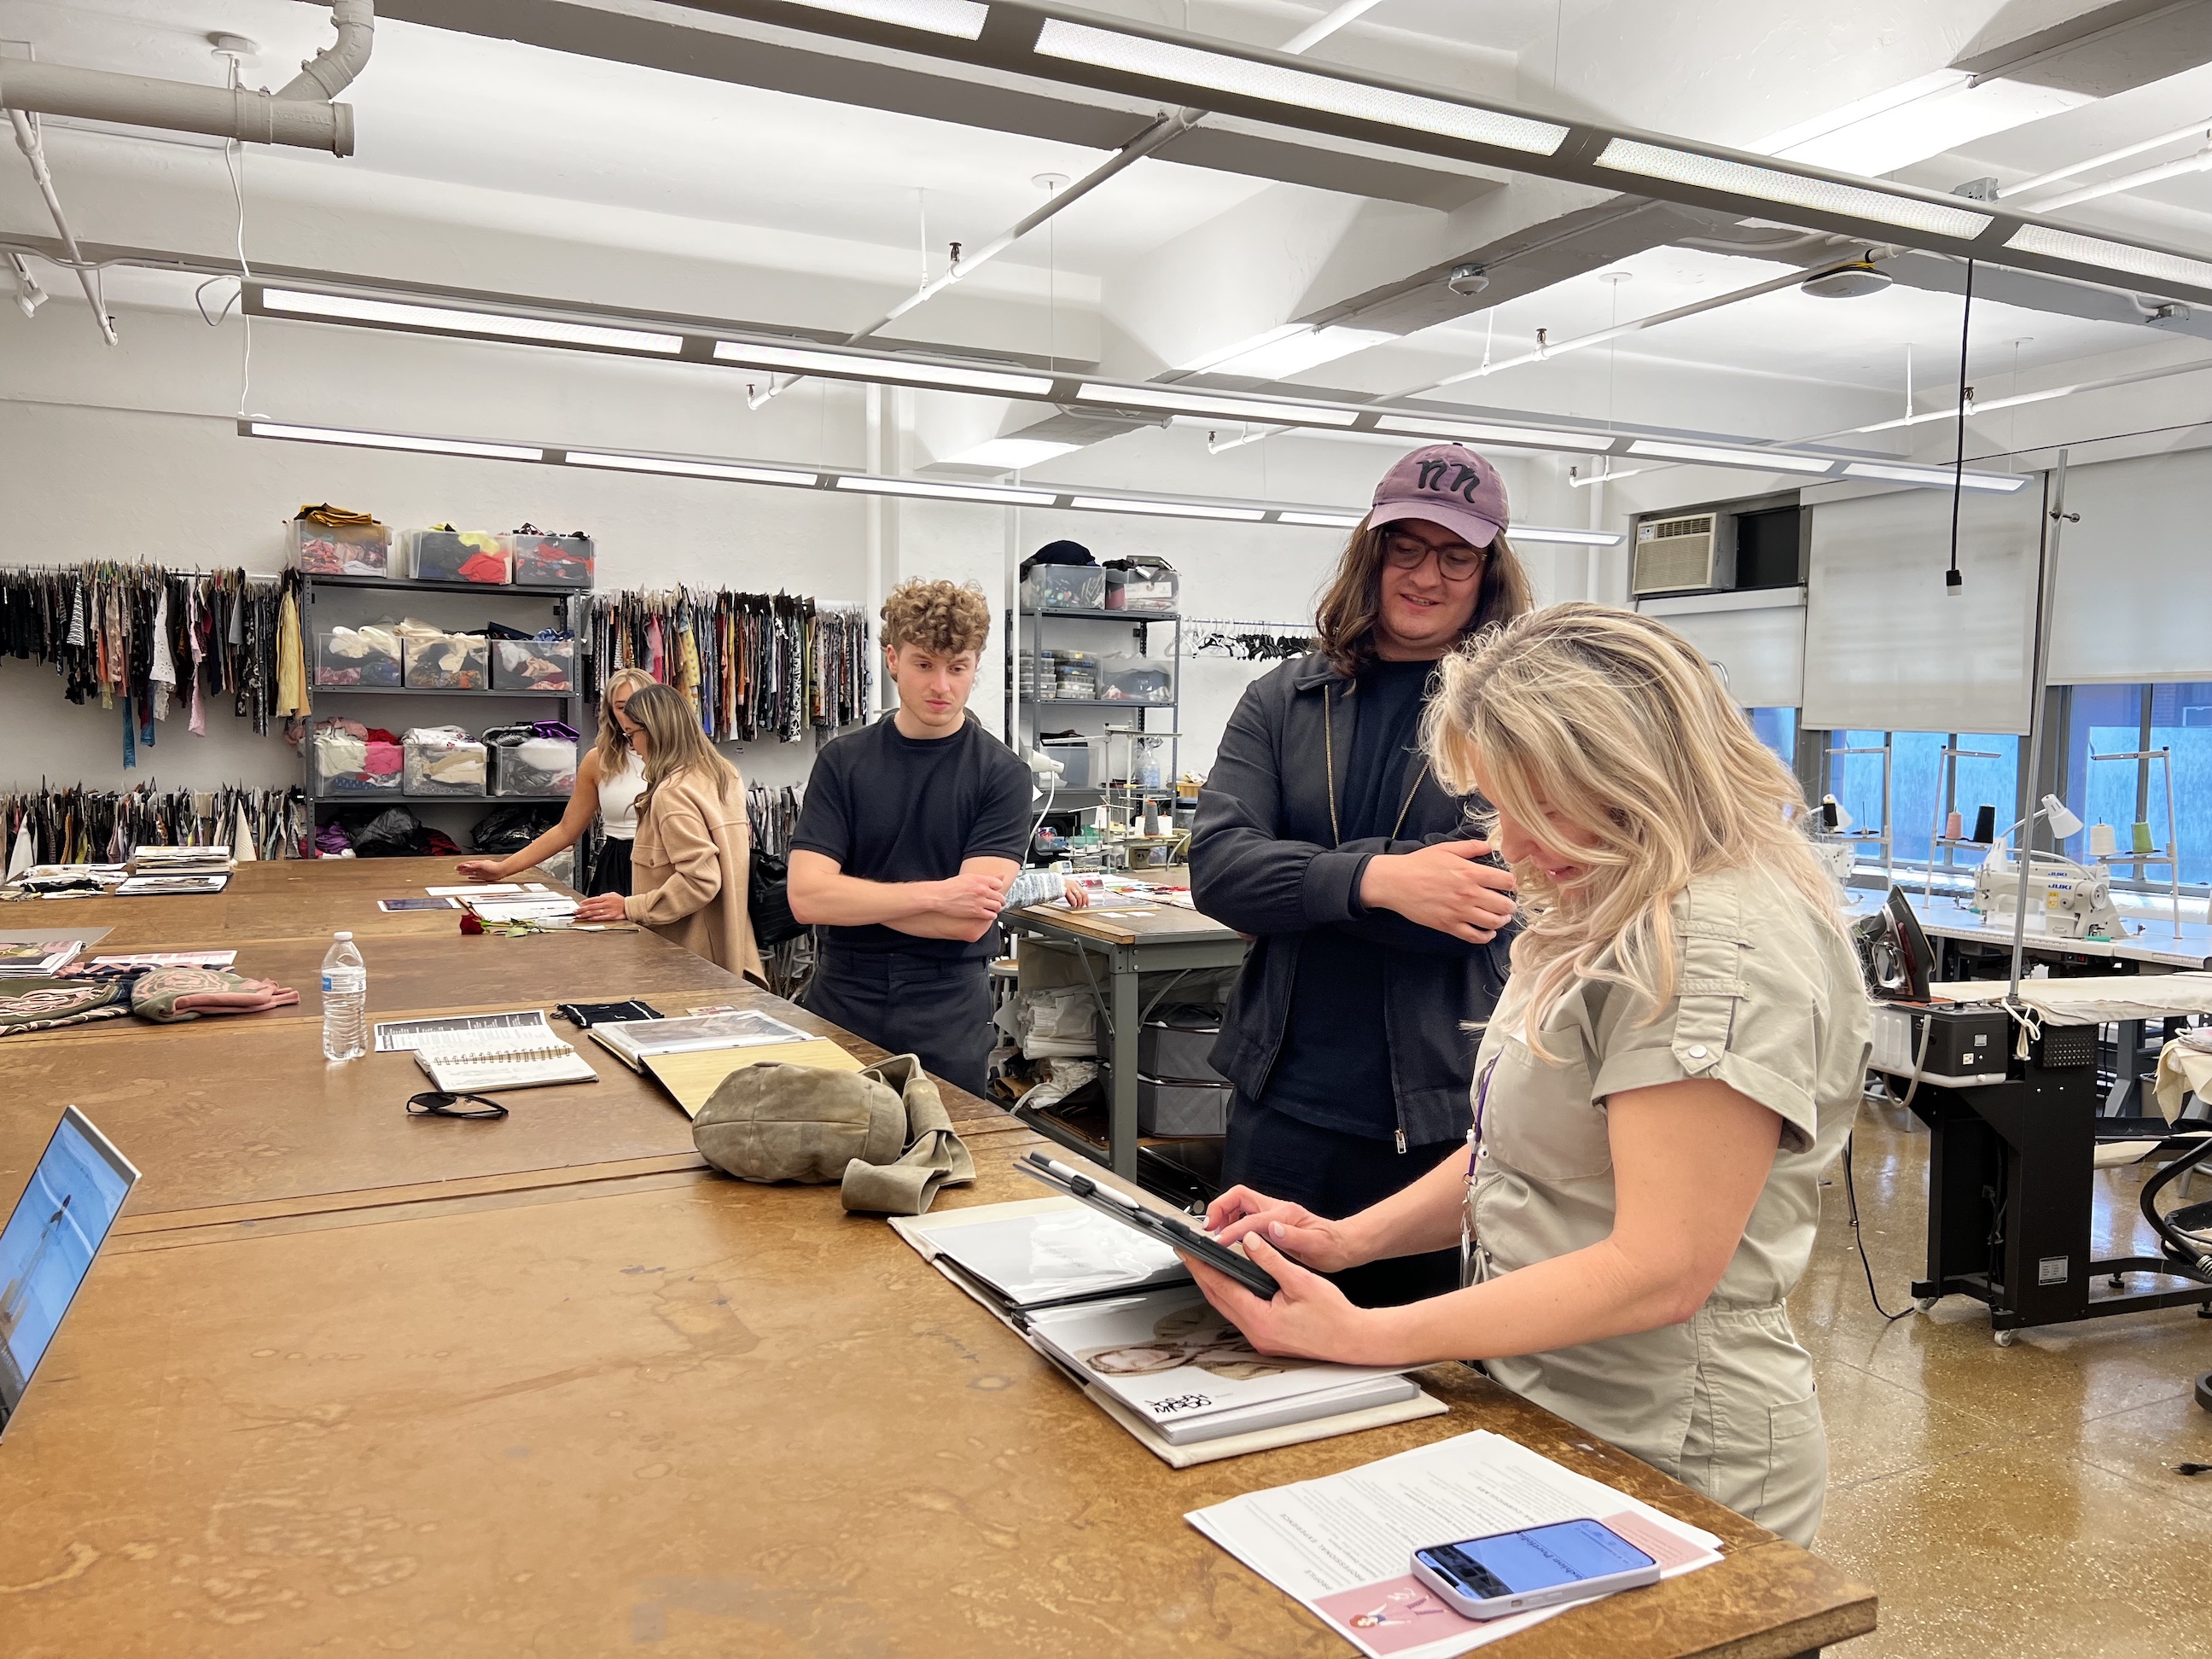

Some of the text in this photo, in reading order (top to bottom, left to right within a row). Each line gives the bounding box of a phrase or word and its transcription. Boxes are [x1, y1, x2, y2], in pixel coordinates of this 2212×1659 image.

[1280, 1513, 1318, 1543] EXPERIENCE
[1318, 1544, 1365, 1581] PROFESSIONAL
[1552, 1557, 1584, 1580] ashion
[1304, 1569, 1332, 1590] PROFILE
